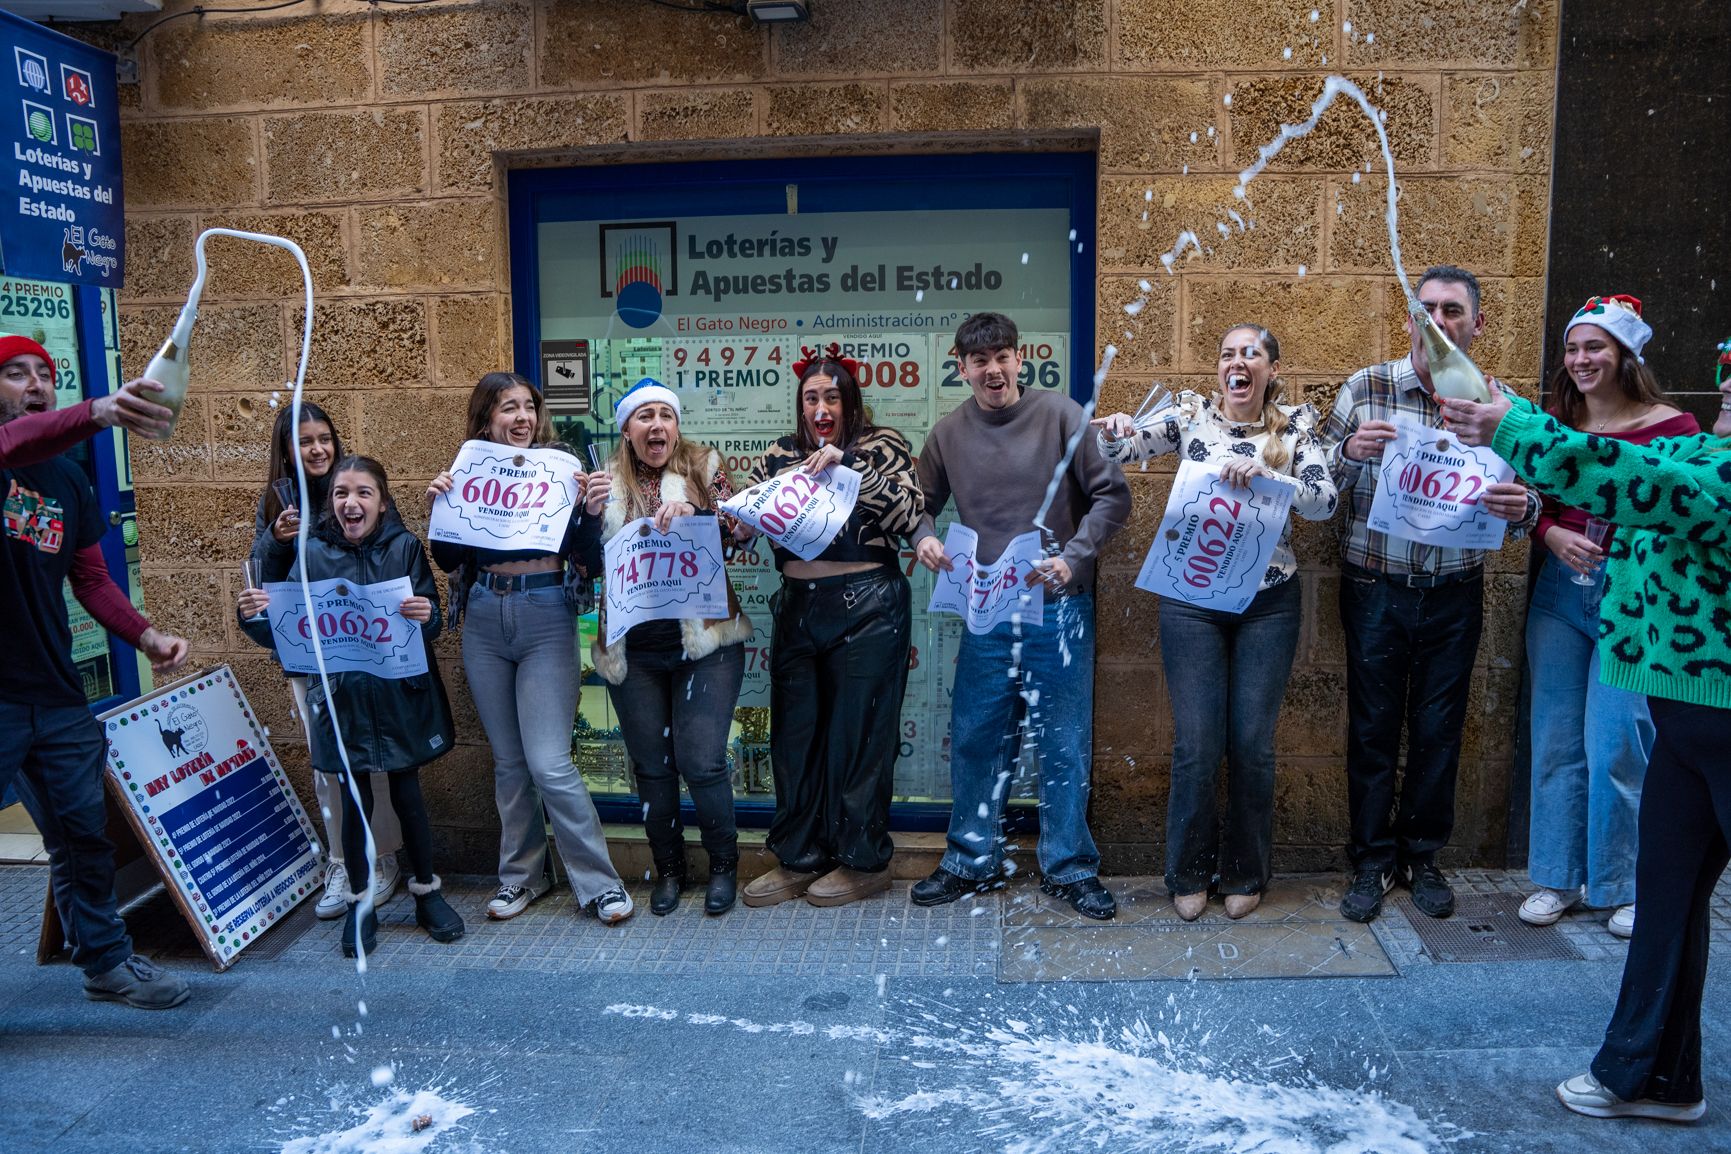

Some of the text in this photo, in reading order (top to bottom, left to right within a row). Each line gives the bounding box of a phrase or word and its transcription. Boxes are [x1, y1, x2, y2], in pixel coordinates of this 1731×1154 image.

[14, 142, 92, 180] Loterías y
[19, 169, 112, 205] Apuestas del
[19, 197, 76, 223] Estado
[71, 225, 84, 244] El
[688, 230, 838, 264] Loterías y
[14, 283, 64, 298] PREMIO
[690, 262, 1002, 302] Apuestas del Estado
[0, 295, 70, 320] 25296
[677, 317, 690, 332] El
[696, 317, 734, 331] Gato
[738, 316, 788, 332] Negro
[812, 313, 934, 328] Administración
[940, 313, 958, 326] nº
[840, 343, 910, 358] REMIO
[695, 368, 780, 388] PREMIO
[855, 360, 920, 388] 008
[490, 466, 537, 478] 5 PREMIO
[1420, 451, 1466, 468] PREMIO
[462, 476, 550, 510] 60622
[1398, 462, 1482, 506] 60622
[478, 506, 514, 518] VENDIDO
[748, 480, 781, 518] 5 PREMIO
[760, 474, 821, 536] 0622
[1436, 502, 1458, 513] AQUÍ
[781, 512, 807, 544] VENDIDO
[1177, 514, 1200, 556] PREMIO
[631, 539, 672, 553] PREMIO
[1183, 496, 1242, 589] 60622
[1216, 545, 1236, 580] VENDIDO
[1232, 522, 1246, 544] AQUÍ
[617, 551, 699, 594] 74778
[626, 579, 659, 596] VENDIDO
[660, 578, 682, 588] AQUÍ
[317, 599, 364, 612] 5 PREMIO
[298, 610, 392, 643] 60622
[320, 636, 360, 646] VENDIDO
[144, 752, 214, 796] HAY LOTERÍA
[199, 769, 216, 785] DE
[232, 907, 254, 928] RESERVA
[252, 893, 271, 912] LOTERÍA
